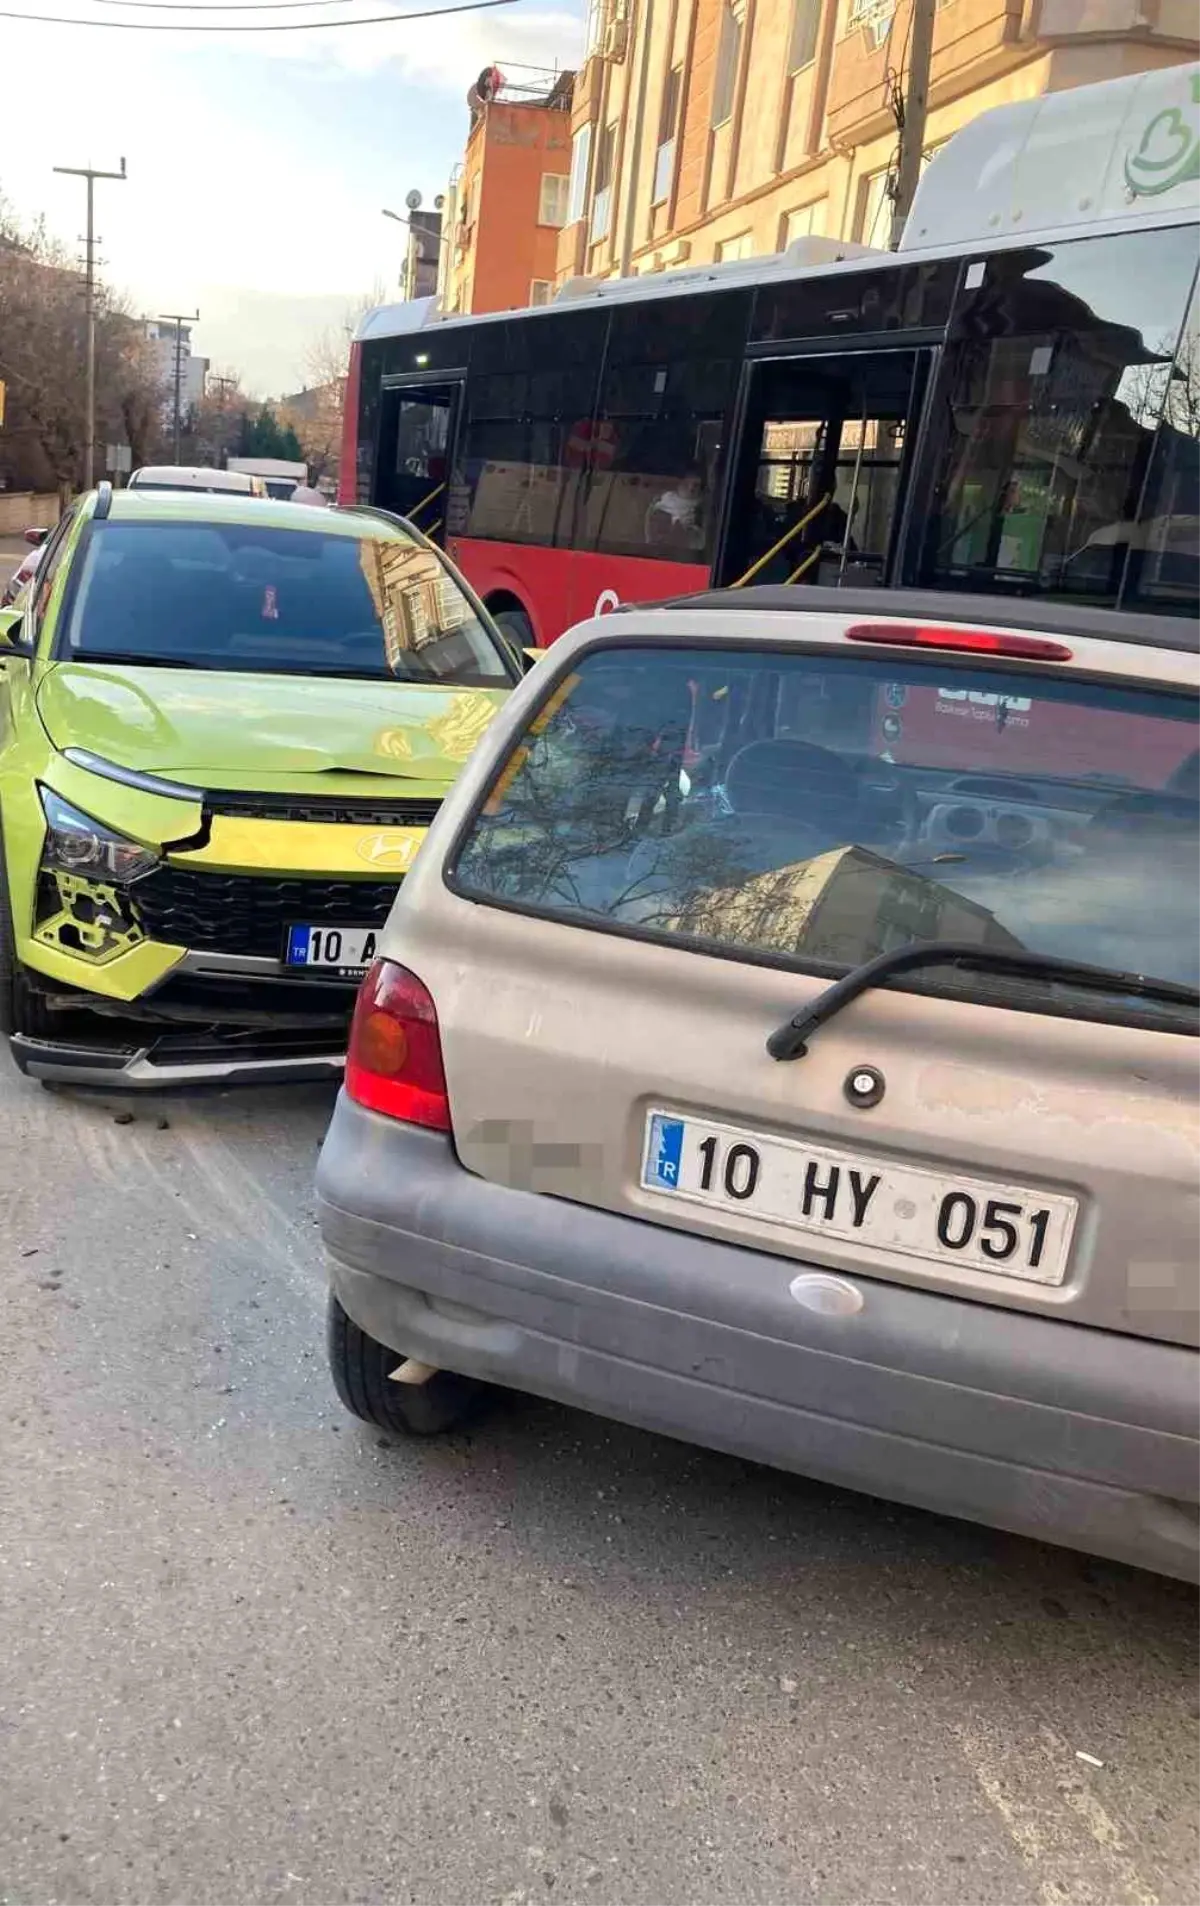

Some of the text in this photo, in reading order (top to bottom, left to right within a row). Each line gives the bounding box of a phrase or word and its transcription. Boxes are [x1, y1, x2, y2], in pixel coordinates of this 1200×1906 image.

[311, 930, 377, 963] 10 A
[656, 1160, 677, 1180] TR
[699, 1136, 1052, 1267] 10 HY 051
